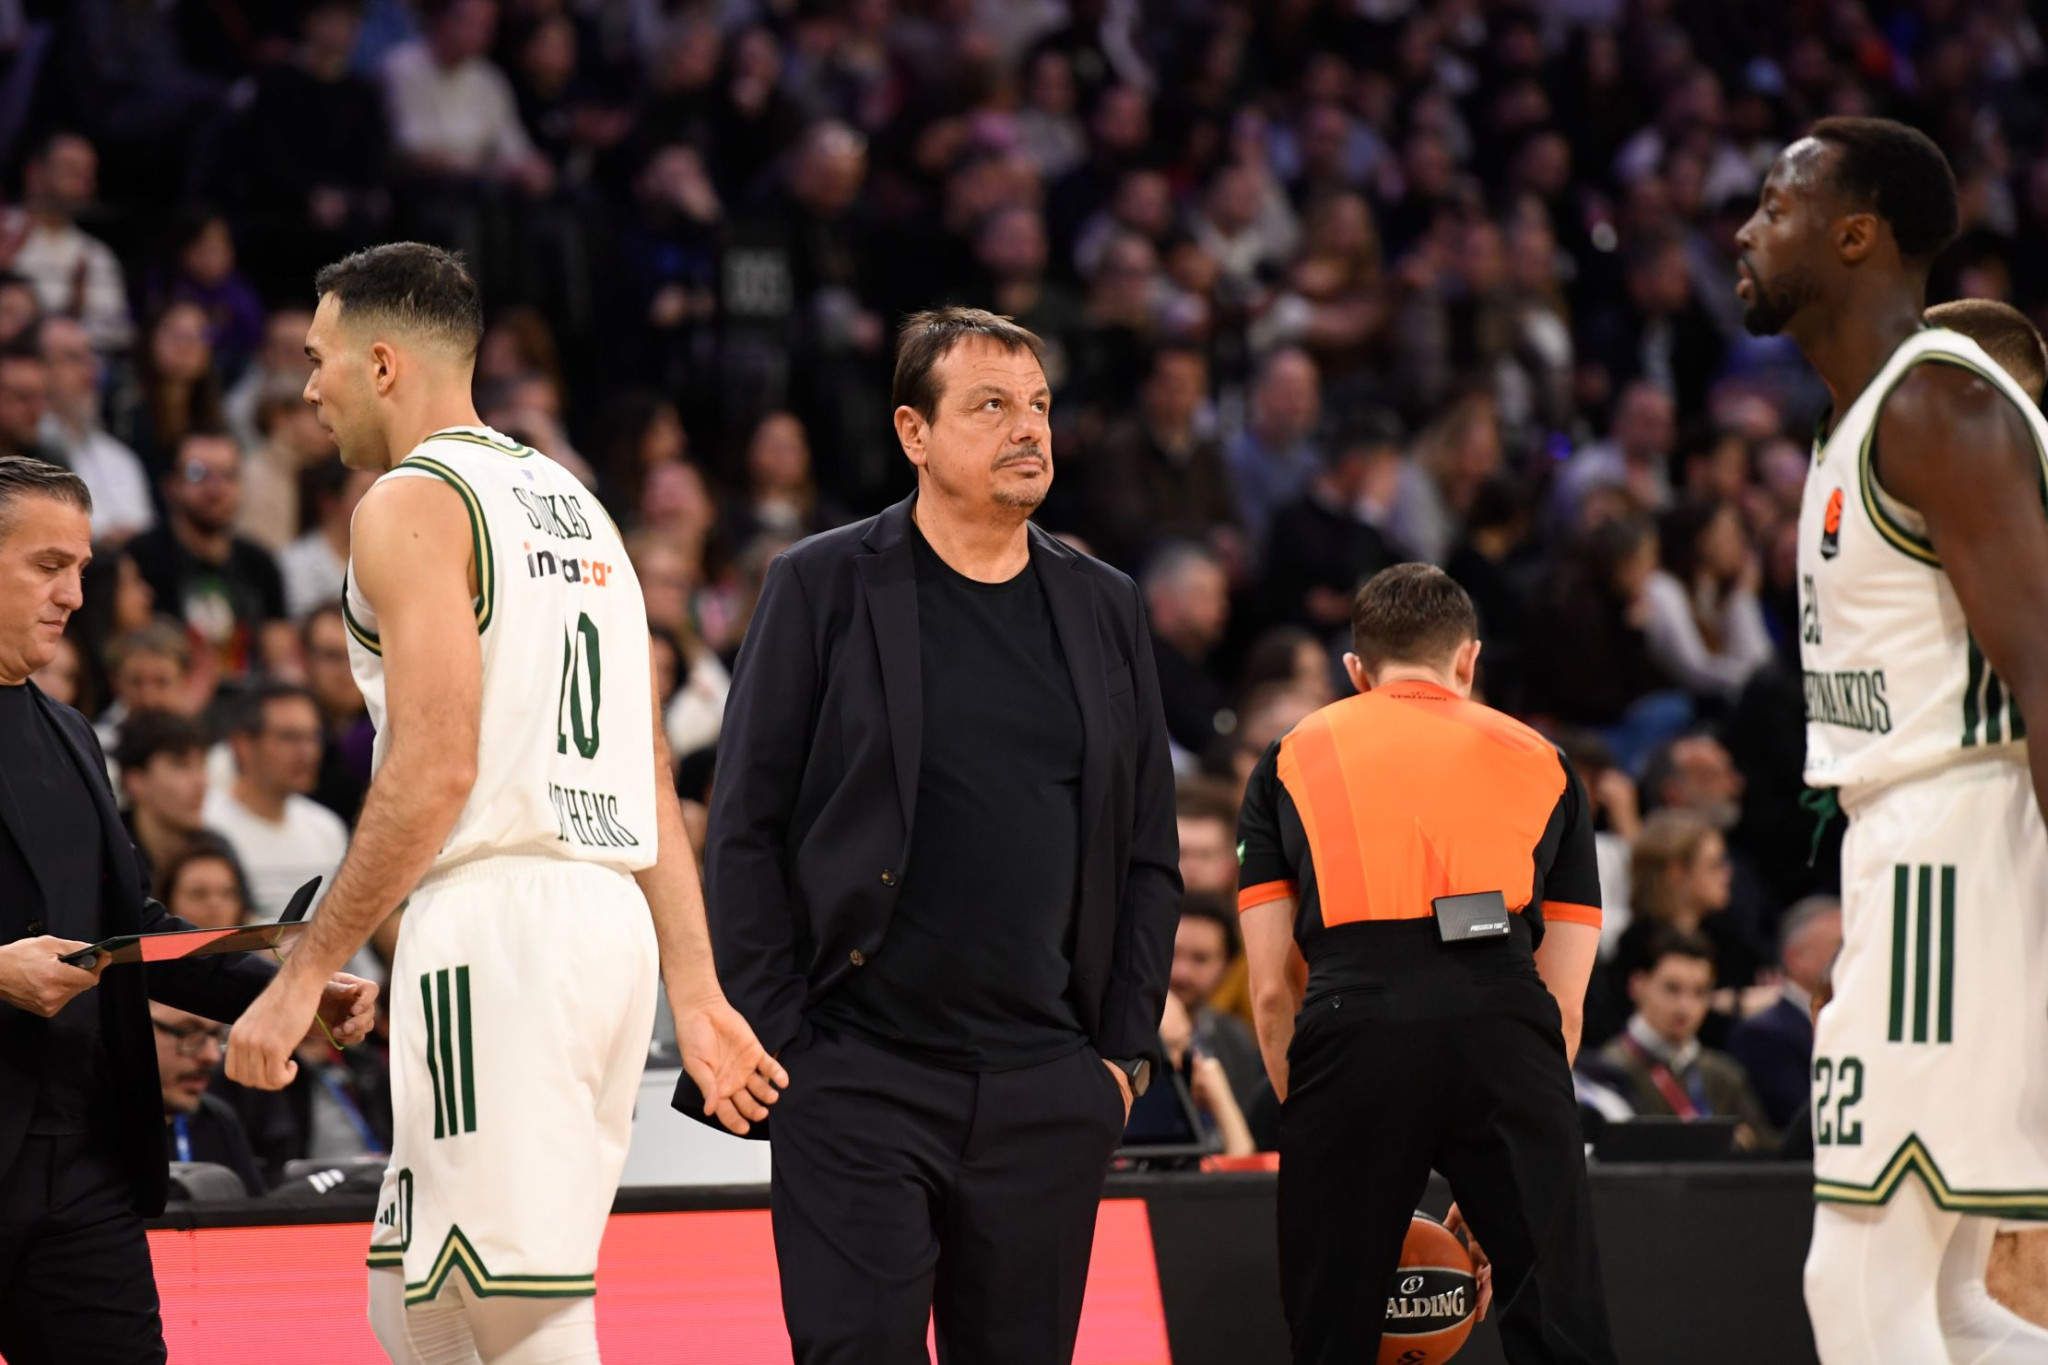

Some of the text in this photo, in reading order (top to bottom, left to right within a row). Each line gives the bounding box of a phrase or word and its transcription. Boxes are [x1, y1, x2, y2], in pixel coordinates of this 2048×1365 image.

[512, 487, 592, 540] SKAS
[549, 781, 639, 848] THENS
[1814, 1056, 1864, 1145] 22
[1385, 1286, 1466, 1319] ALDING
